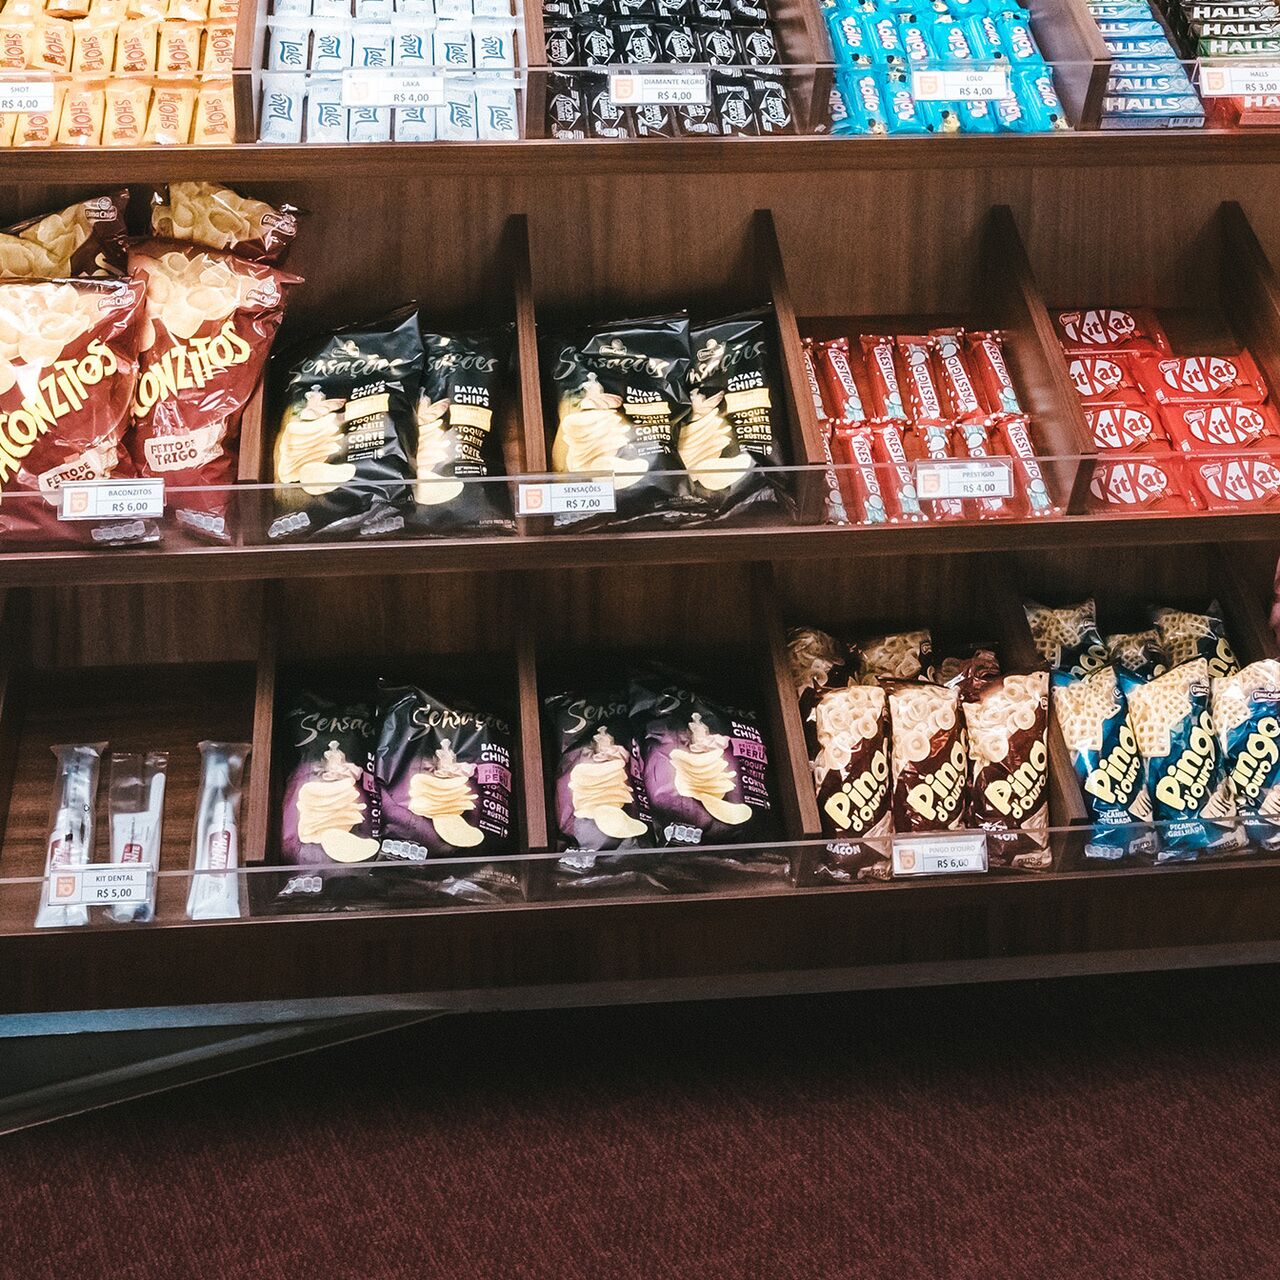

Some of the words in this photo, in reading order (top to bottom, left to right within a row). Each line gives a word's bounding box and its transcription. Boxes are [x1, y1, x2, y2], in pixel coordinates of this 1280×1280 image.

[1210, 41, 1280, 52] HALLS
[959, 87, 971, 96] R$
[973, 87, 993, 96] 4,00
[1245, 83, 1257, 92] R$
[1259, 83, 1277, 92] 3,00
[394, 93, 406, 103] R$
[408, 93, 429, 102] 4,00
[658, 91, 670, 100] R$
[671, 91, 692, 101] 4,00
[1, 99, 14, 109] R$
[16, 99, 38, 109] 4,00
[982, 339, 1010, 387] PRESTIGIO
[829, 348, 856, 395] PRESTIGIO
[728, 372, 762, 383] BATATA
[454, 385, 489, 396] BATATA
[728, 379, 764, 392] CHIPS
[454, 393, 489, 406] CHIPS
[736, 425, 771, 434] CORTE
[744, 433, 771, 441] RÚSTICO
[150, 441, 182, 455] FEITO
[155, 448, 198, 466] TRIGO
[108, 489, 152, 497] BACONZITOS
[564, 485, 602, 494] SENSAÇÕES
[963, 484, 976, 493] R$
[977, 483, 996, 493] 4,00
[112, 503, 125, 512] R$
[126, 502, 148, 511] 6,00
[566, 499, 578, 509] R$
[579, 499, 600, 508] 7,00
[1155, 710, 1215, 811] Pingo
[1184, 758, 1214, 810] d'ouro
[851, 784, 886, 832] d'ouro
[827, 843, 861, 855] BACON
[97, 889, 109, 899] R$
[111, 889, 131, 899] 5,00
